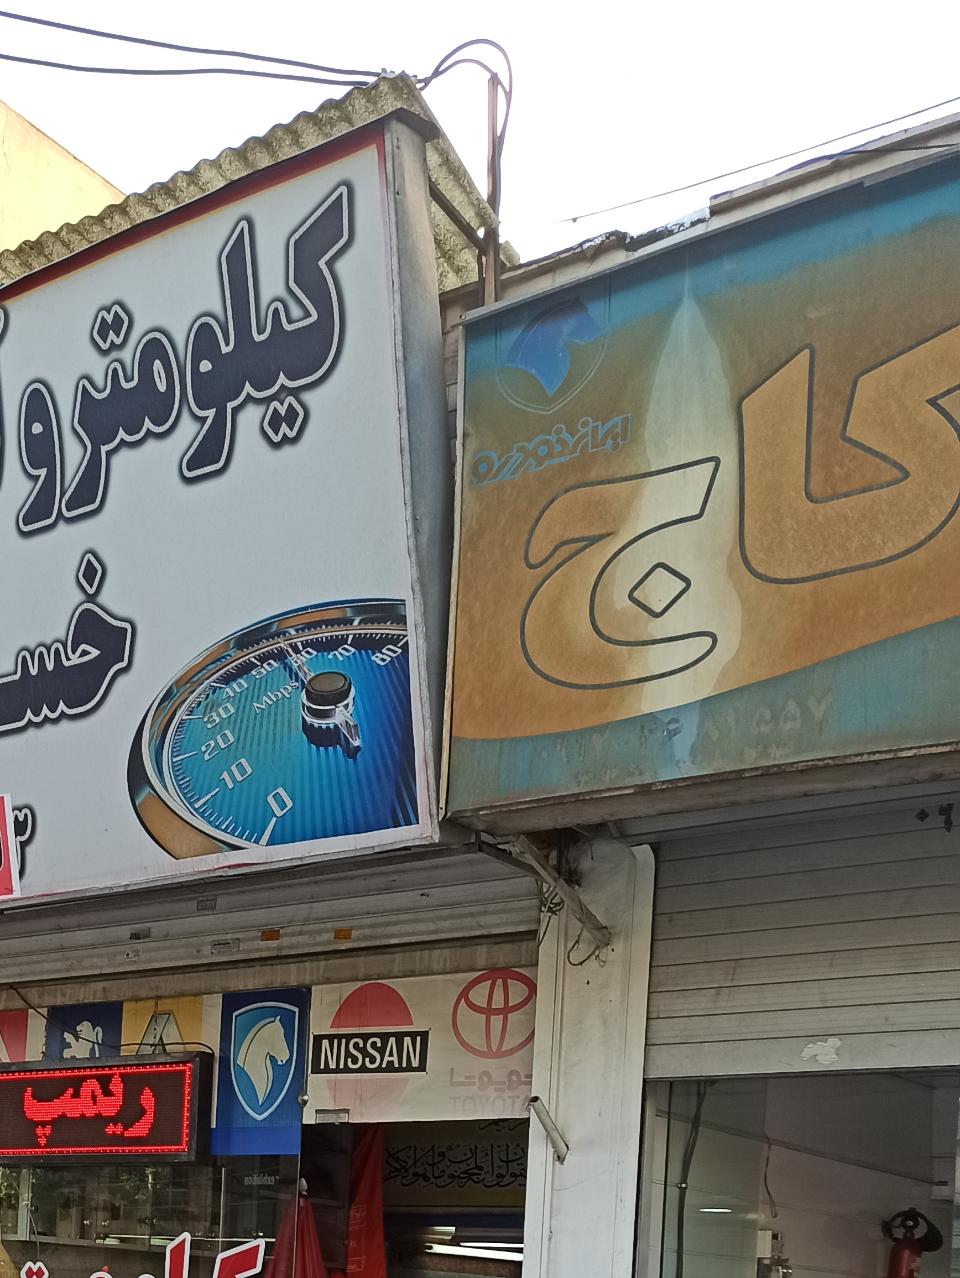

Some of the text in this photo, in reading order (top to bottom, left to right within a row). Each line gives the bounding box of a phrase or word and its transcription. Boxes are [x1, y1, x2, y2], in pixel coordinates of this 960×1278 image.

[65, 181, 354, 517] کیلومتر
[250, 659, 279, 679] 50
[329, 644, 356, 662] 70
[372, 644, 402, 666] 80
[222, 679, 248, 700] 40
[252, 679, 300, 714] Mbps
[203, 703, 235, 730] 30
[201, 729, 235, 761] 20
[220, 758, 253, 790] 10
[267, 786, 293, 818] 0
[320, 1036, 420, 1069] NISSAN
[24, 1073, 156, 1147] ریمپ
